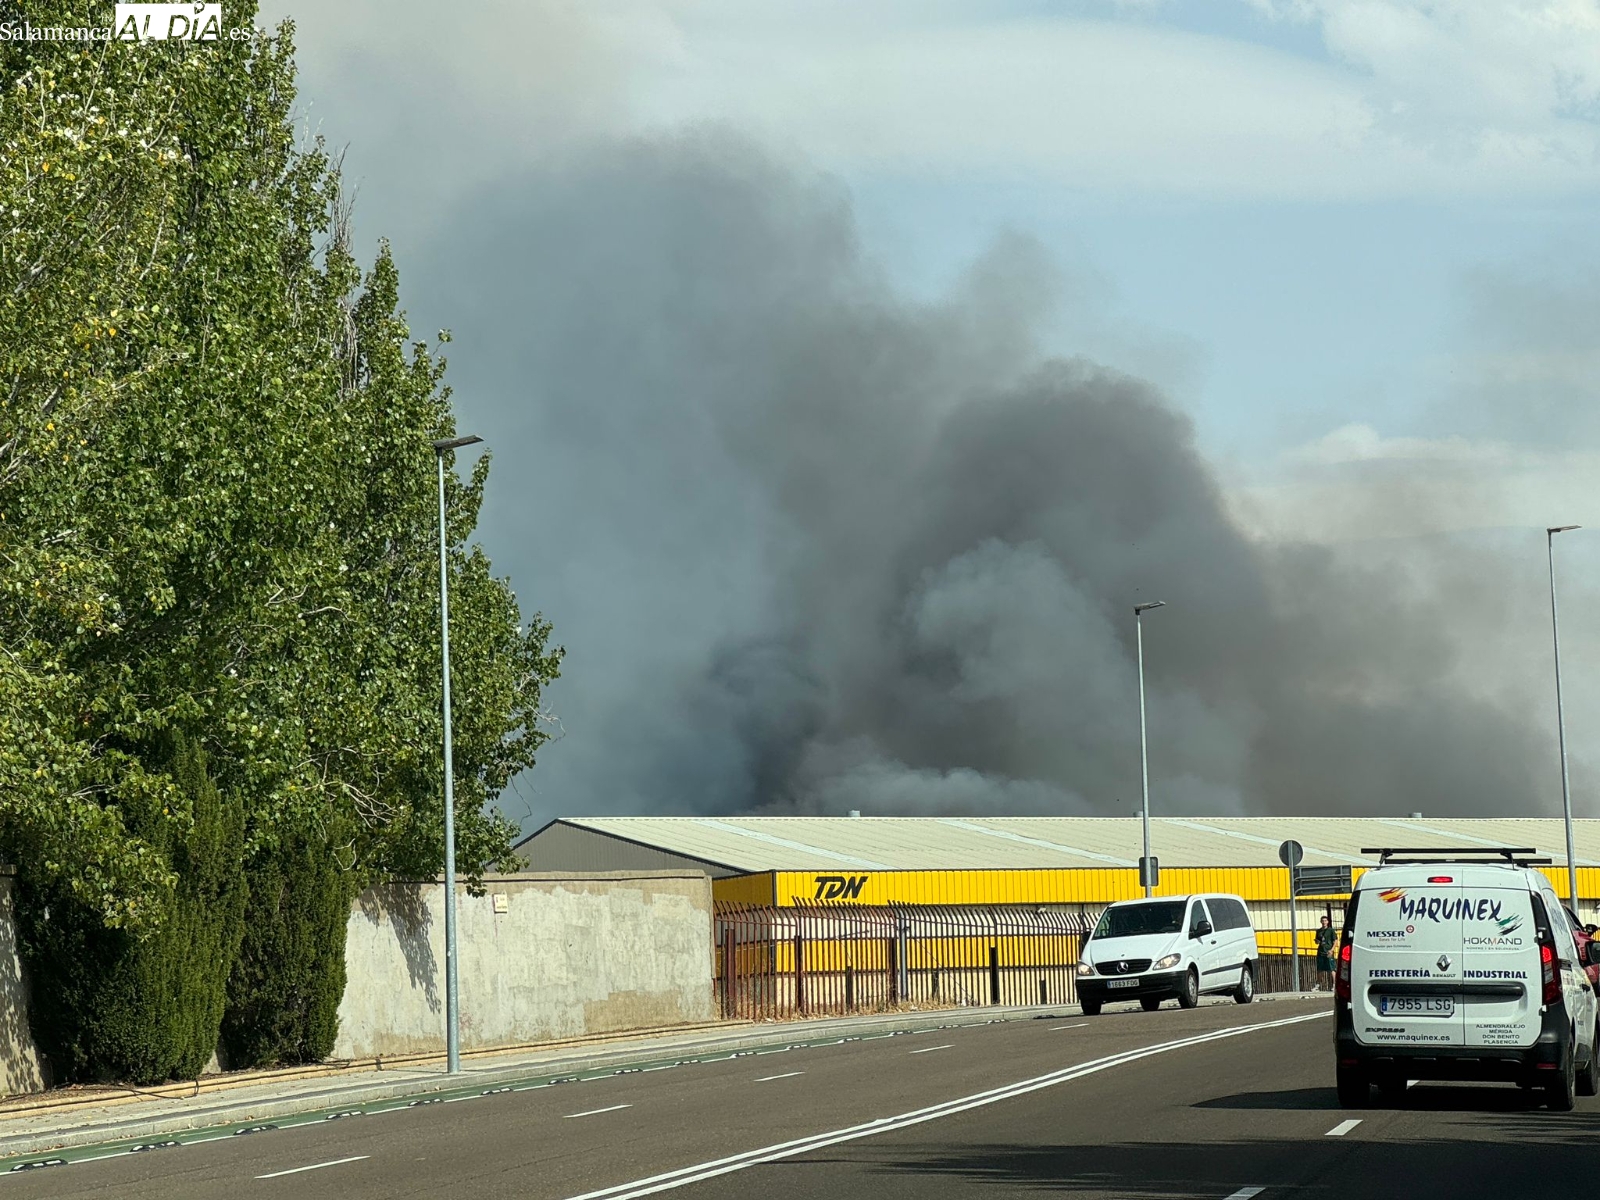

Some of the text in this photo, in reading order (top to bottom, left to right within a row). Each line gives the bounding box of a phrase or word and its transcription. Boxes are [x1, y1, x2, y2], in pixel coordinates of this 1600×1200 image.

[813, 876, 868, 900] TDN
[1399, 896, 1502, 923] MAQUINEX
[1366, 930, 1406, 938] MESSER
[1463, 937, 1523, 946] HOKMAND
[1369, 968, 1431, 978] FERRETERÍA
[1463, 970, 1528, 979] INDUSTRIAL
[1389, 998, 1451, 1011] 7955 LSG
[1376, 1034, 1450, 1042] www.maquinex.es
